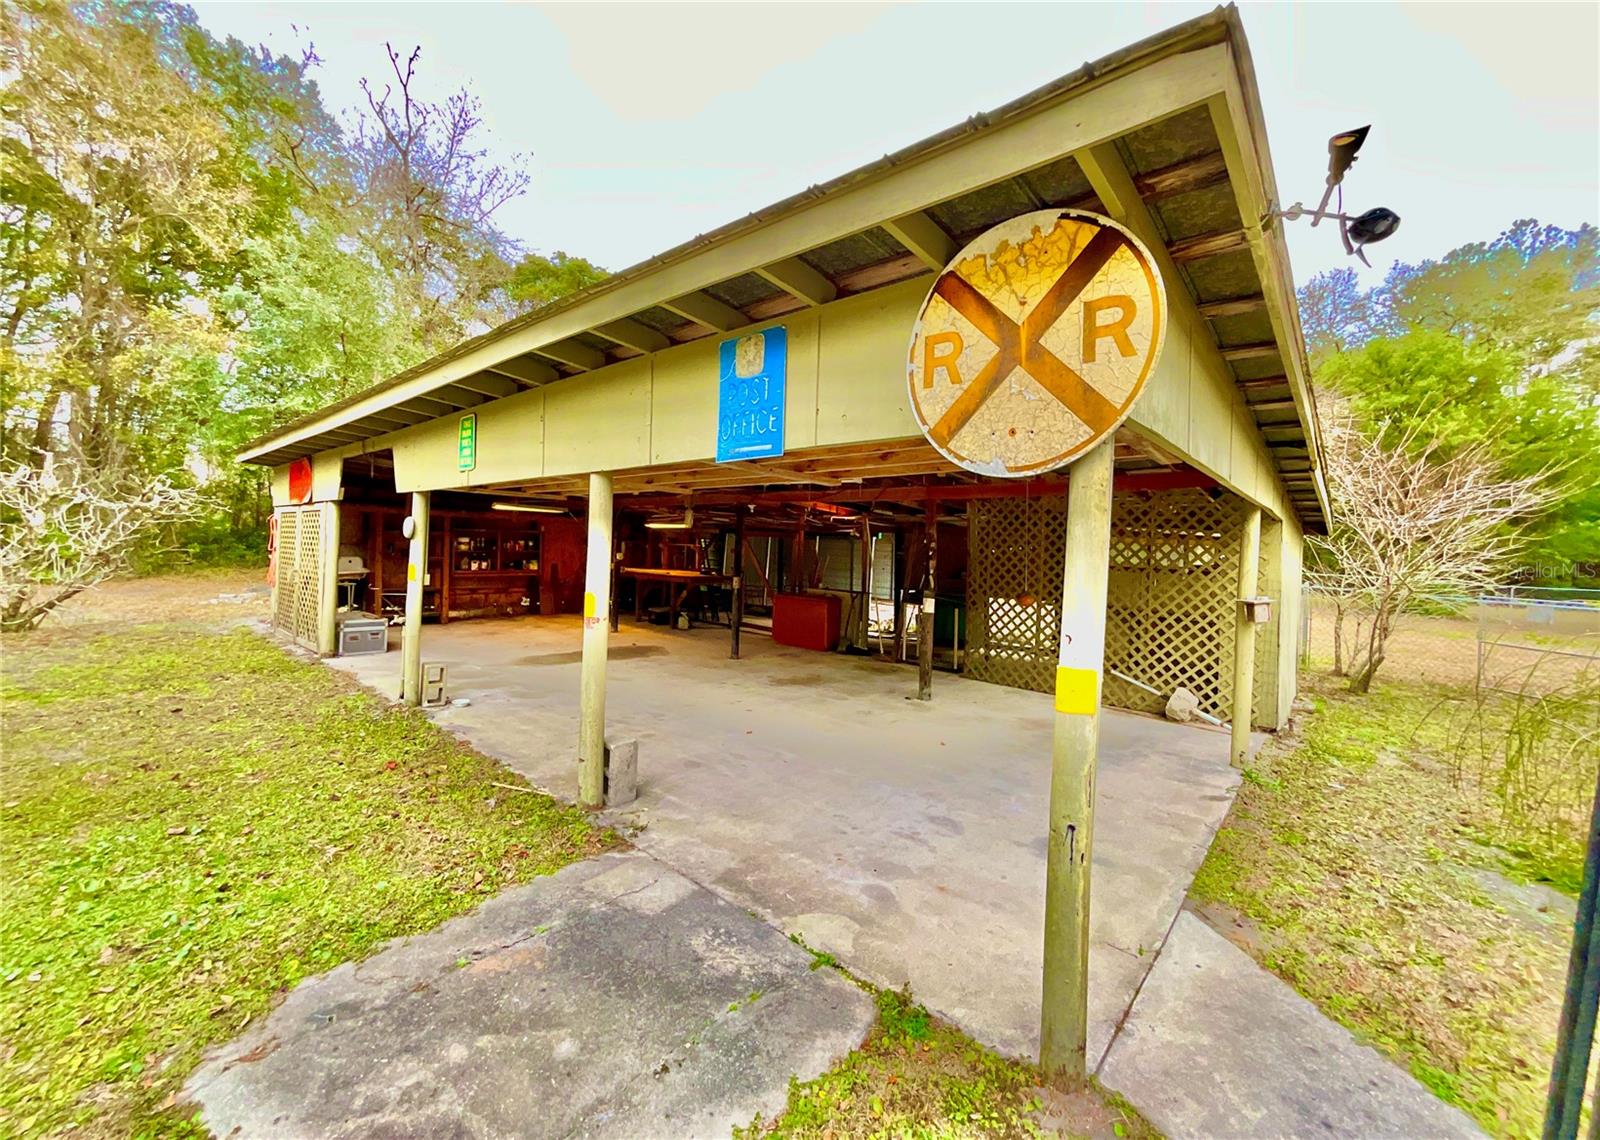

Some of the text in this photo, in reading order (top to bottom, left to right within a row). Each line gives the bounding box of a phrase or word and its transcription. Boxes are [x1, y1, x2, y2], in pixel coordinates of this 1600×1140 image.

[924, 295, 1138, 389] R R
[729, 376, 769, 405] POST
[721, 406, 778, 441] OFFICE
